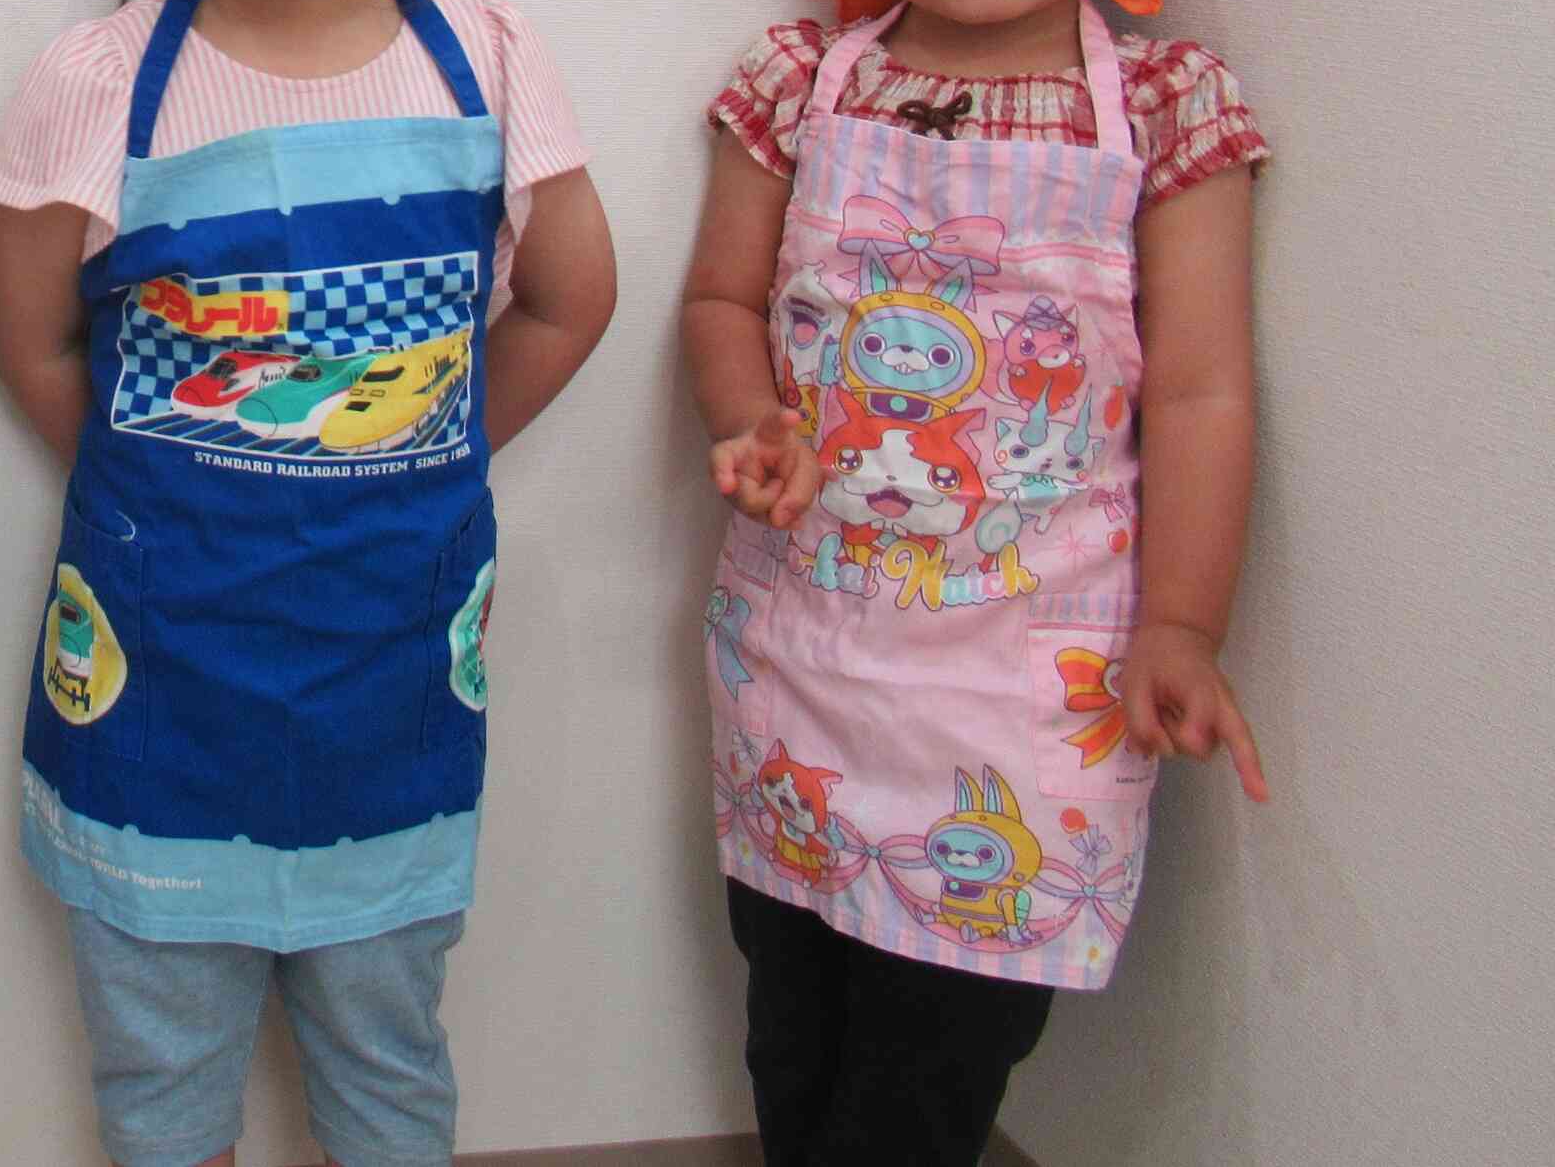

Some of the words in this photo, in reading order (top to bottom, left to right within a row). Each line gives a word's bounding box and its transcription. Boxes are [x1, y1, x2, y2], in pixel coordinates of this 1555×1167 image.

[194, 451, 273, 474] STANDARD
[276, 462, 351, 478] RAILROAD
[354, 460, 409, 477] SYSTEM
[414, 452, 449, 469] SINCE
